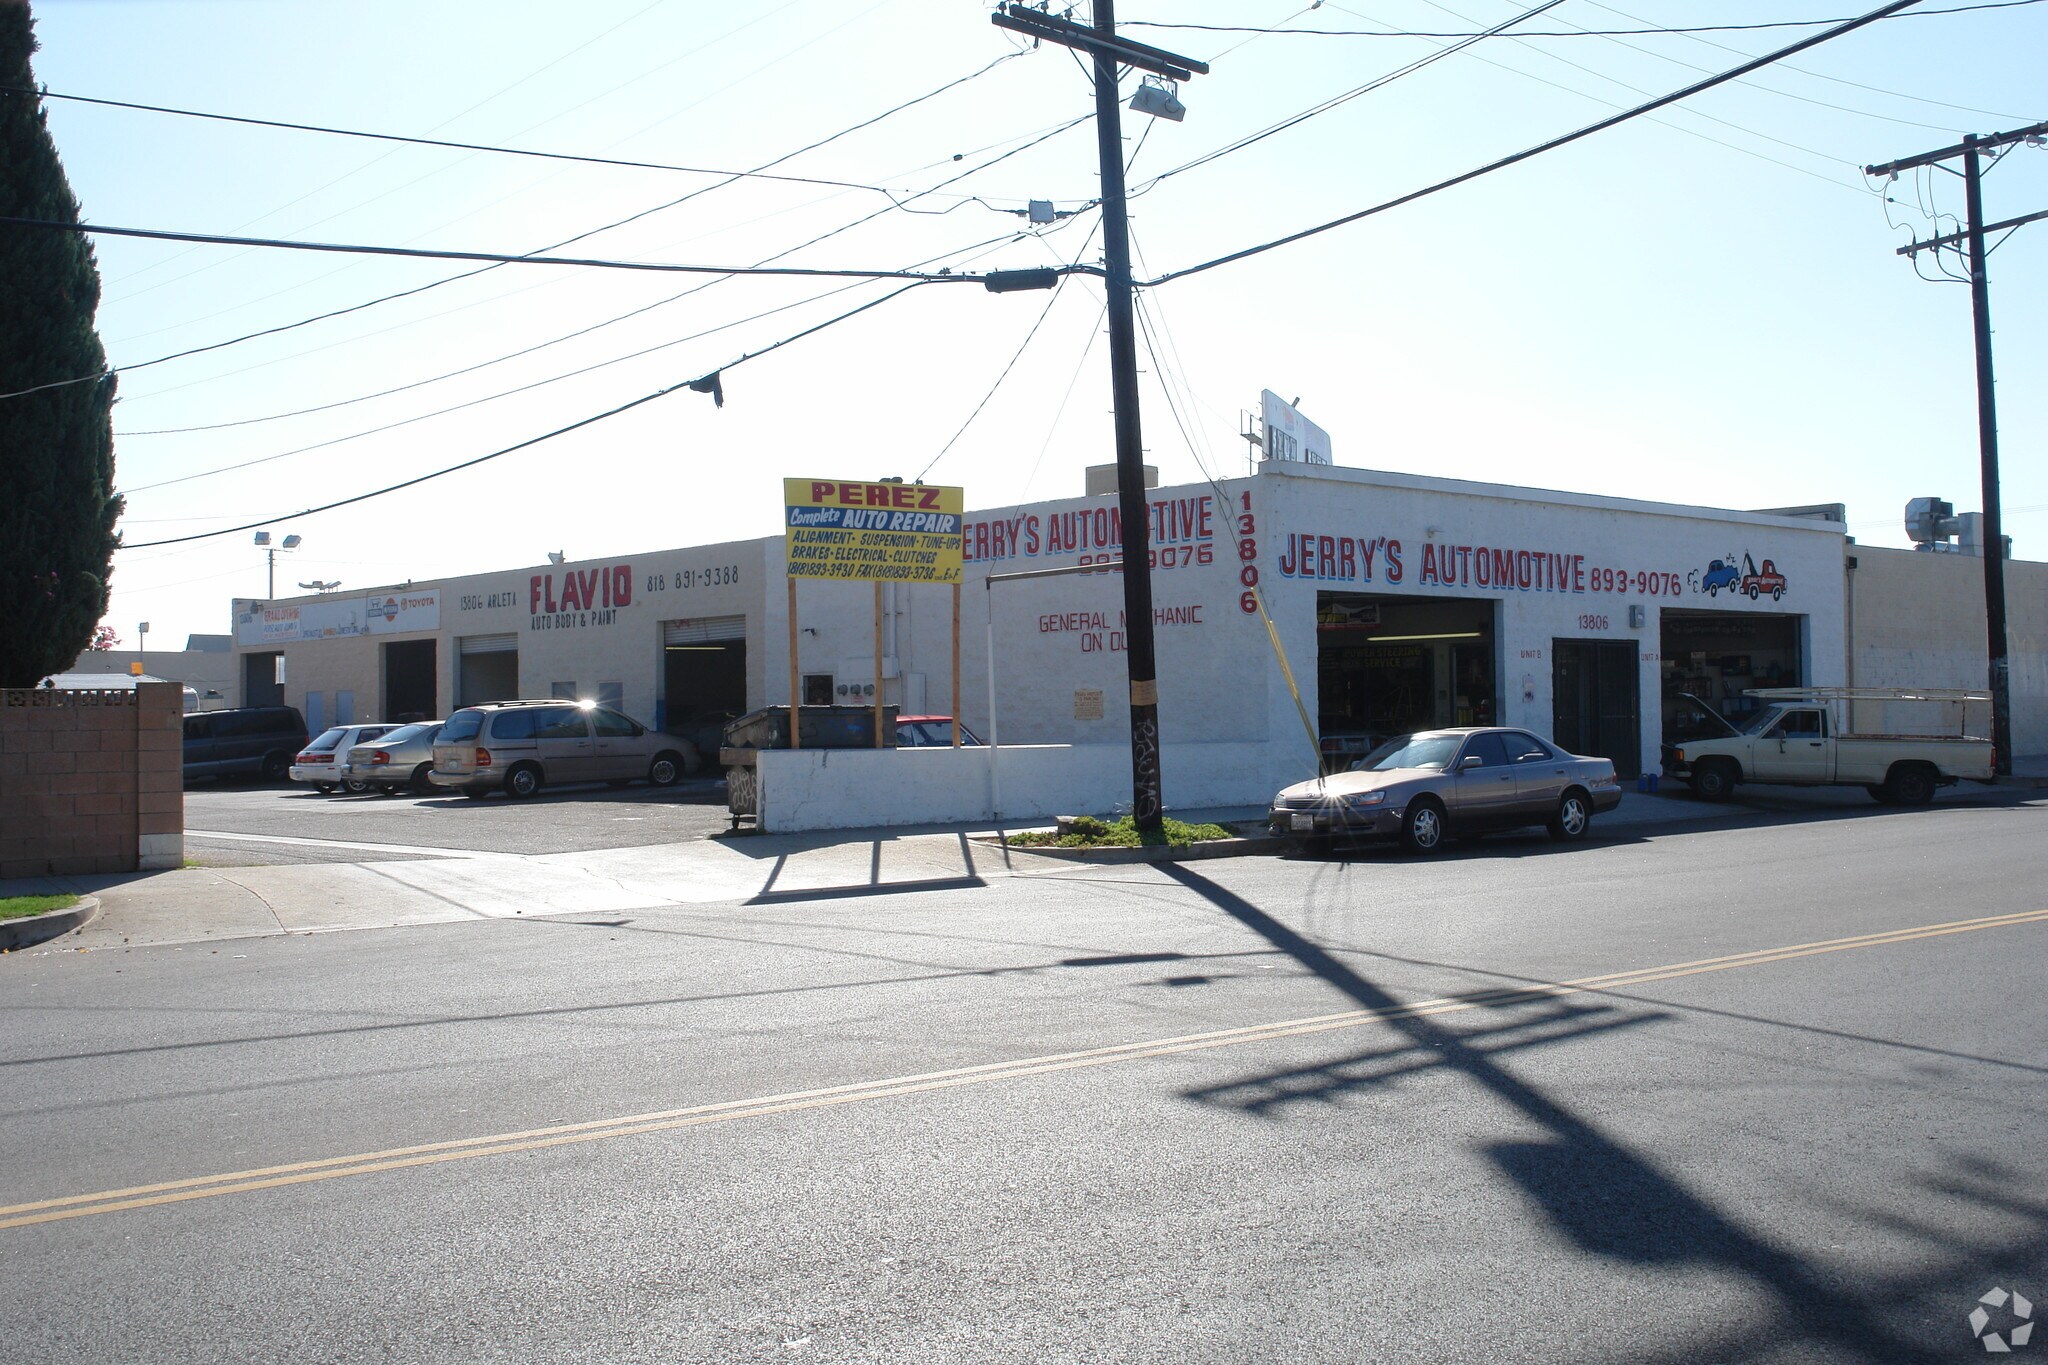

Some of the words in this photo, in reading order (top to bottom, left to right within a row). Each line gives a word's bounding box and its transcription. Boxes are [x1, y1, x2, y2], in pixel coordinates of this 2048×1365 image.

[812, 482, 940, 510] PEREZ
[790, 507, 840, 526] Complete
[842, 509, 887, 530] AUTO
[889, 512, 955, 533] REPAIR
[922, 535, 961, 550] TUNE-UPS
[962, 512, 1040, 564] ERRY'S
[1279, 533, 1403, 584] JERRY'S
[1420, 543, 1585, 594] AUTOMOTIVE
[530, 565, 632, 615] FLAVIO
[647, 576, 665, 592] 818
[675, 565, 739, 589] 891-9388
[1591, 567, 1682, 597] 893-9076
[408, 597, 434, 607] TOYOTA
[460, 595, 483, 611] 13806
[487, 592, 516, 608] ARLETA
[531, 614, 551, 631] AUTO
[555, 612, 576, 630] BODY
[580, 611, 586, 626] &
[591, 609, 617, 625] PAINT
[1039, 612, 1110, 632] GENERAL
[1120, 605, 1202, 628] MHANIC
[1578, 614, 1609, 630] 13806
[1081, 632, 1103, 652] ON
[1110, 632, 1128, 651] DU
[1521, 650, 1535, 658] UNIT
